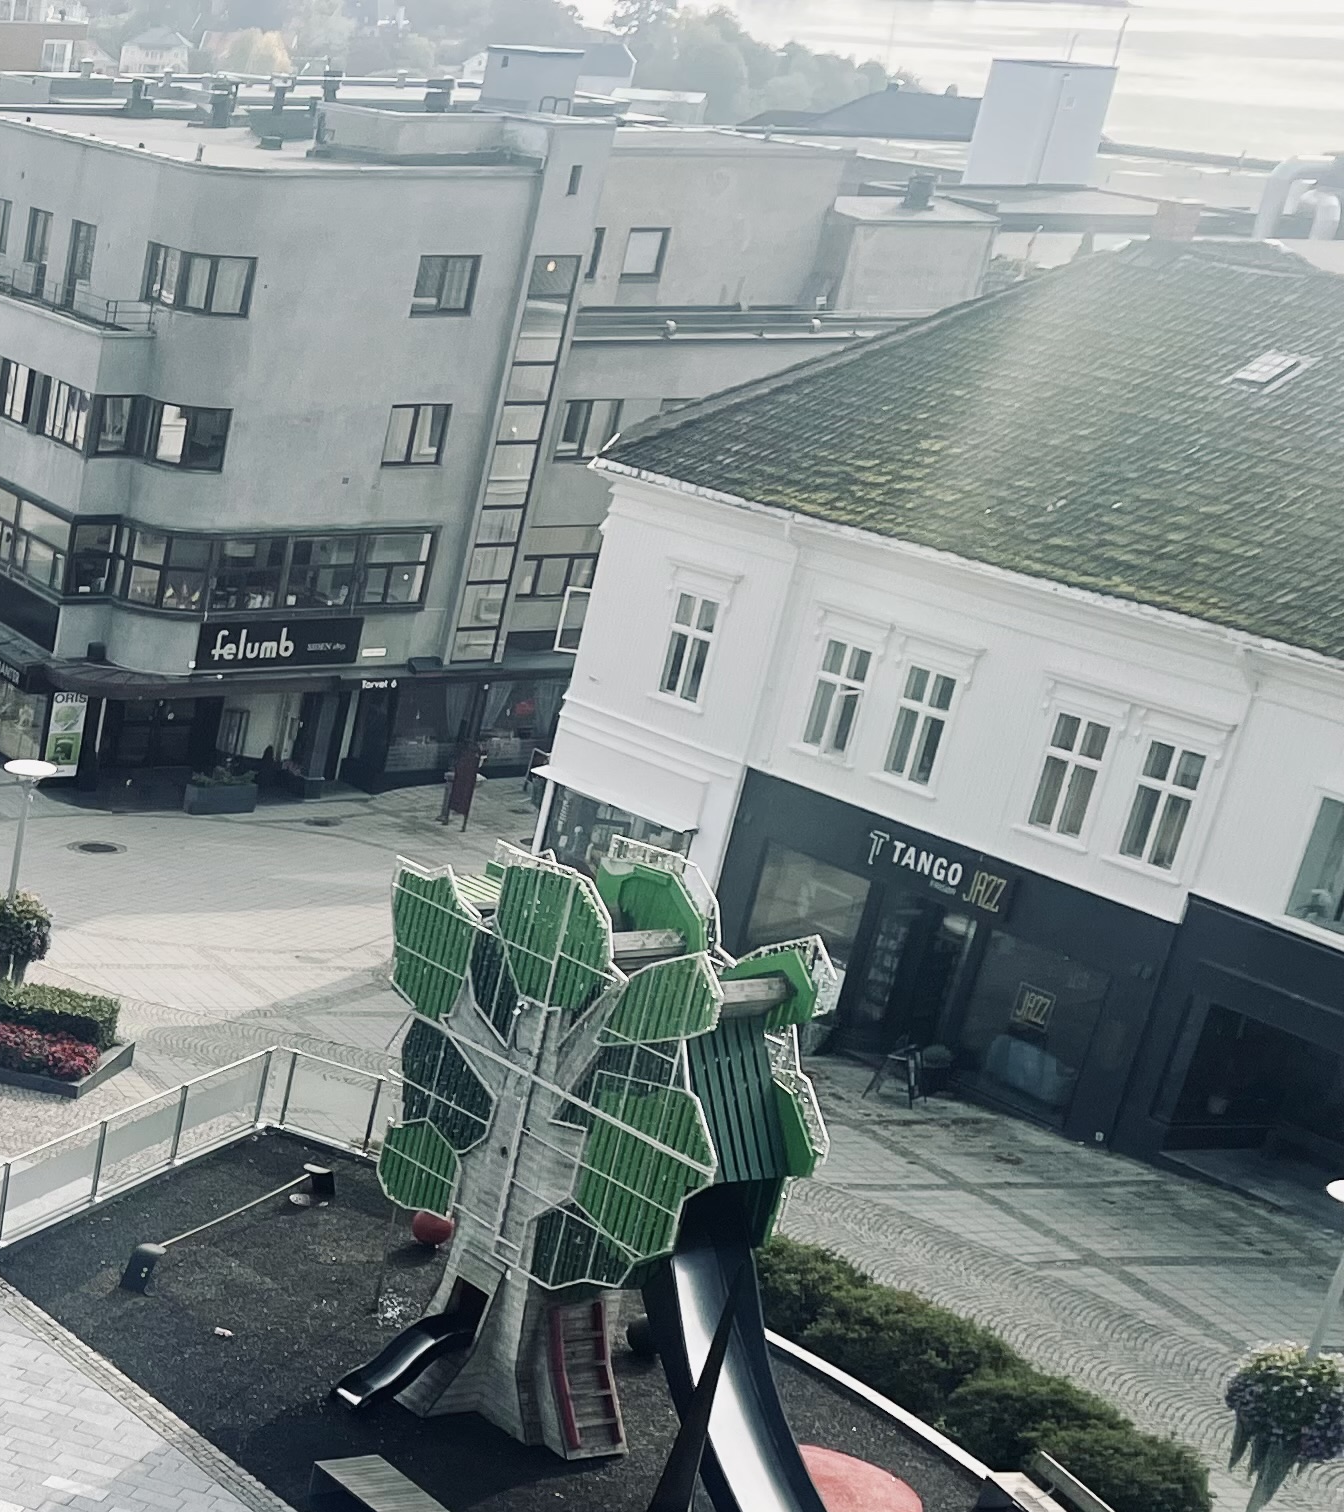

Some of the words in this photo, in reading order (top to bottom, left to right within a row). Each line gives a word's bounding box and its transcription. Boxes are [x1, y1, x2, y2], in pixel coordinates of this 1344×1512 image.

[211, 627, 294, 660] felumb
[362, 680, 388, 689] Torvet
[55, 693, 87, 704] ORIS
[892, 840, 963, 886] TANGO
[963, 870, 1008, 912] JAZZ
